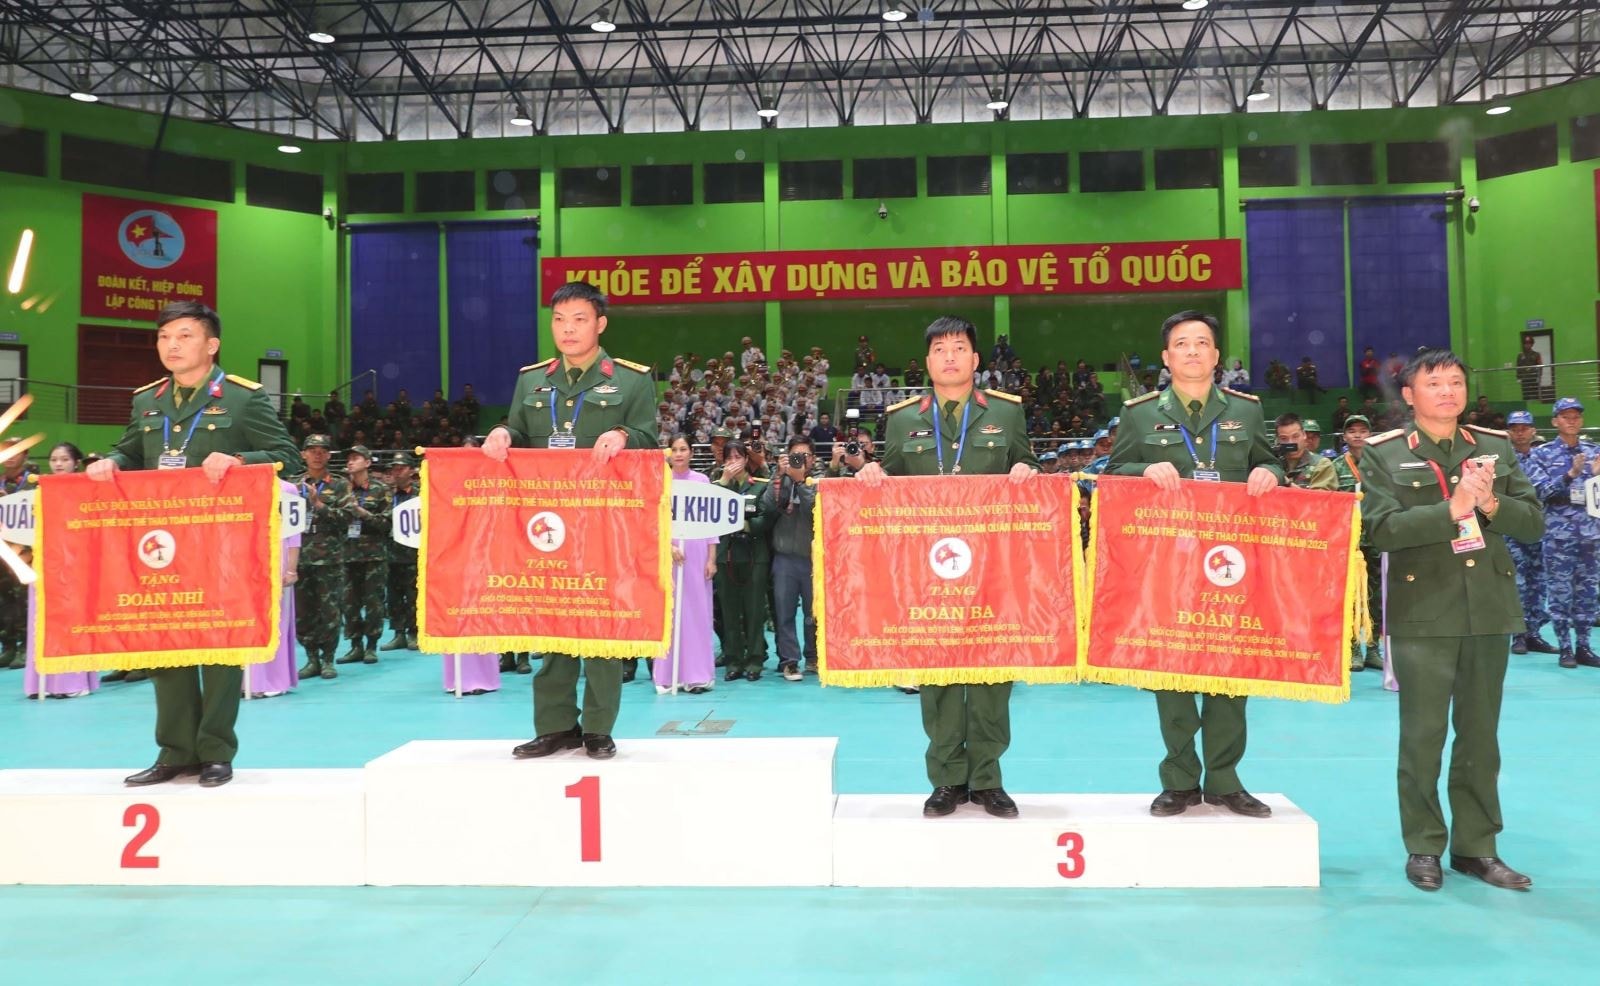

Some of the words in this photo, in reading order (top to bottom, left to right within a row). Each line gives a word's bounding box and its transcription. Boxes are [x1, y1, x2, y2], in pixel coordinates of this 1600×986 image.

[660, 256, 704, 295] ĐỂ
[712, 259, 777, 294] XÂY
[787, 261, 877, 297] DỰNG
[888, 256, 931, 289] VÀ
[941, 251, 1008, 288] BẢO
[1017, 252, 1058, 291] VỆ
[1069, 246, 1111, 286] TỔ
[1121, 245, 1212, 287] QUỐC
[97, 274, 126, 289] ĐOÀN
[128, 275, 150, 292] KẾT,
[152, 278, 175, 295] HIỆP
[176, 281, 203, 296] ĐỒNG
[105, 294, 125, 310] LẬP
[127, 296, 156, 310] CÔNG
[289, 501, 299, 527] 5
[684, 495, 721, 523] KHU
[728, 498, 739, 524] 9
[1135, 506, 1168, 519] QUÂN
[1171, 507, 1193, 520] ĐỘI
[1196, 511, 1230, 523] NHÂN
[1233, 512, 1257, 525] DÂN
[1258, 515, 1288, 529] VIỆT
[1290, 519, 1317, 532] NAM
[526, 557, 568, 571] TẶNG
[140, 573, 180, 587] TẶNG
[487, 571, 545, 589] ĐOÀN
[551, 571, 608, 591] NHẤT
[930, 584, 977, 598] TẶNG
[117, 590, 167, 606] ĐOÀN
[171, 588, 204, 605] NHÌ
[1200, 590, 1247, 604] TẶNG
[909, 603, 965, 620] ĐOÀN
[970, 605, 995, 619] BA
[1177, 609, 1235, 628] ĐOÀN
[1240, 615, 1264, 631] BA
[565, 776, 601, 862] 1
[120, 804, 160, 868] 2
[1057, 832, 1085, 878] 3
